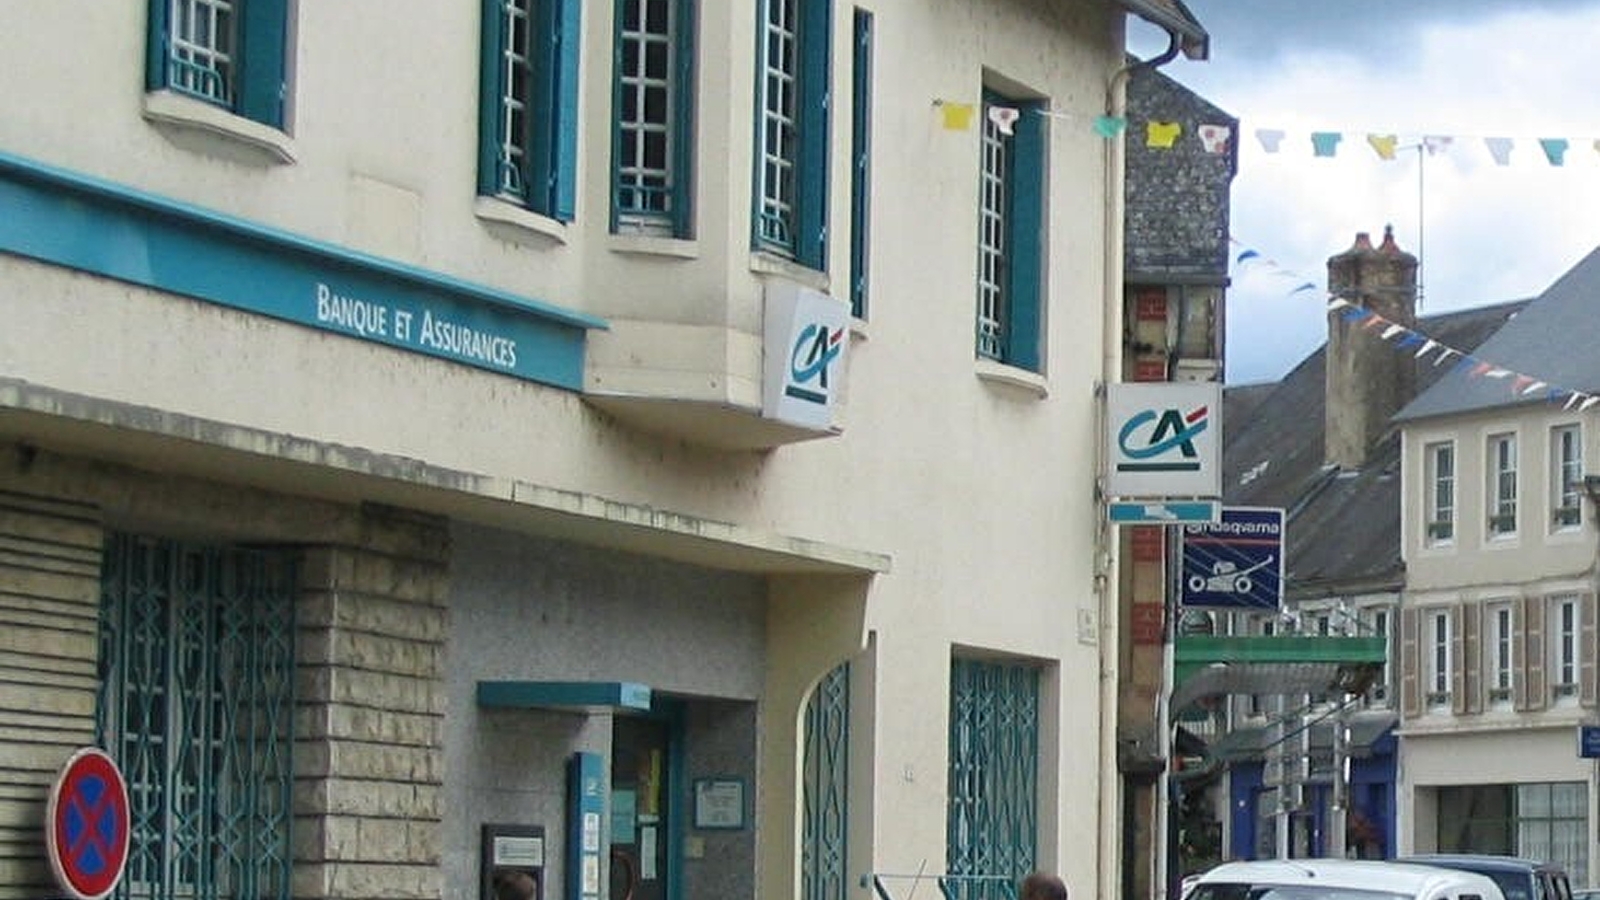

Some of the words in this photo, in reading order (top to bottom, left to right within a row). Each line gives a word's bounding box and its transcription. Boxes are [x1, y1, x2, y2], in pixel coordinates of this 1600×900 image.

[316, 282, 387, 336] BANQUE
[394, 310, 413, 341] ET
[420, 310, 517, 369] ASSURANCES
[1119, 406, 1208, 459] CA
